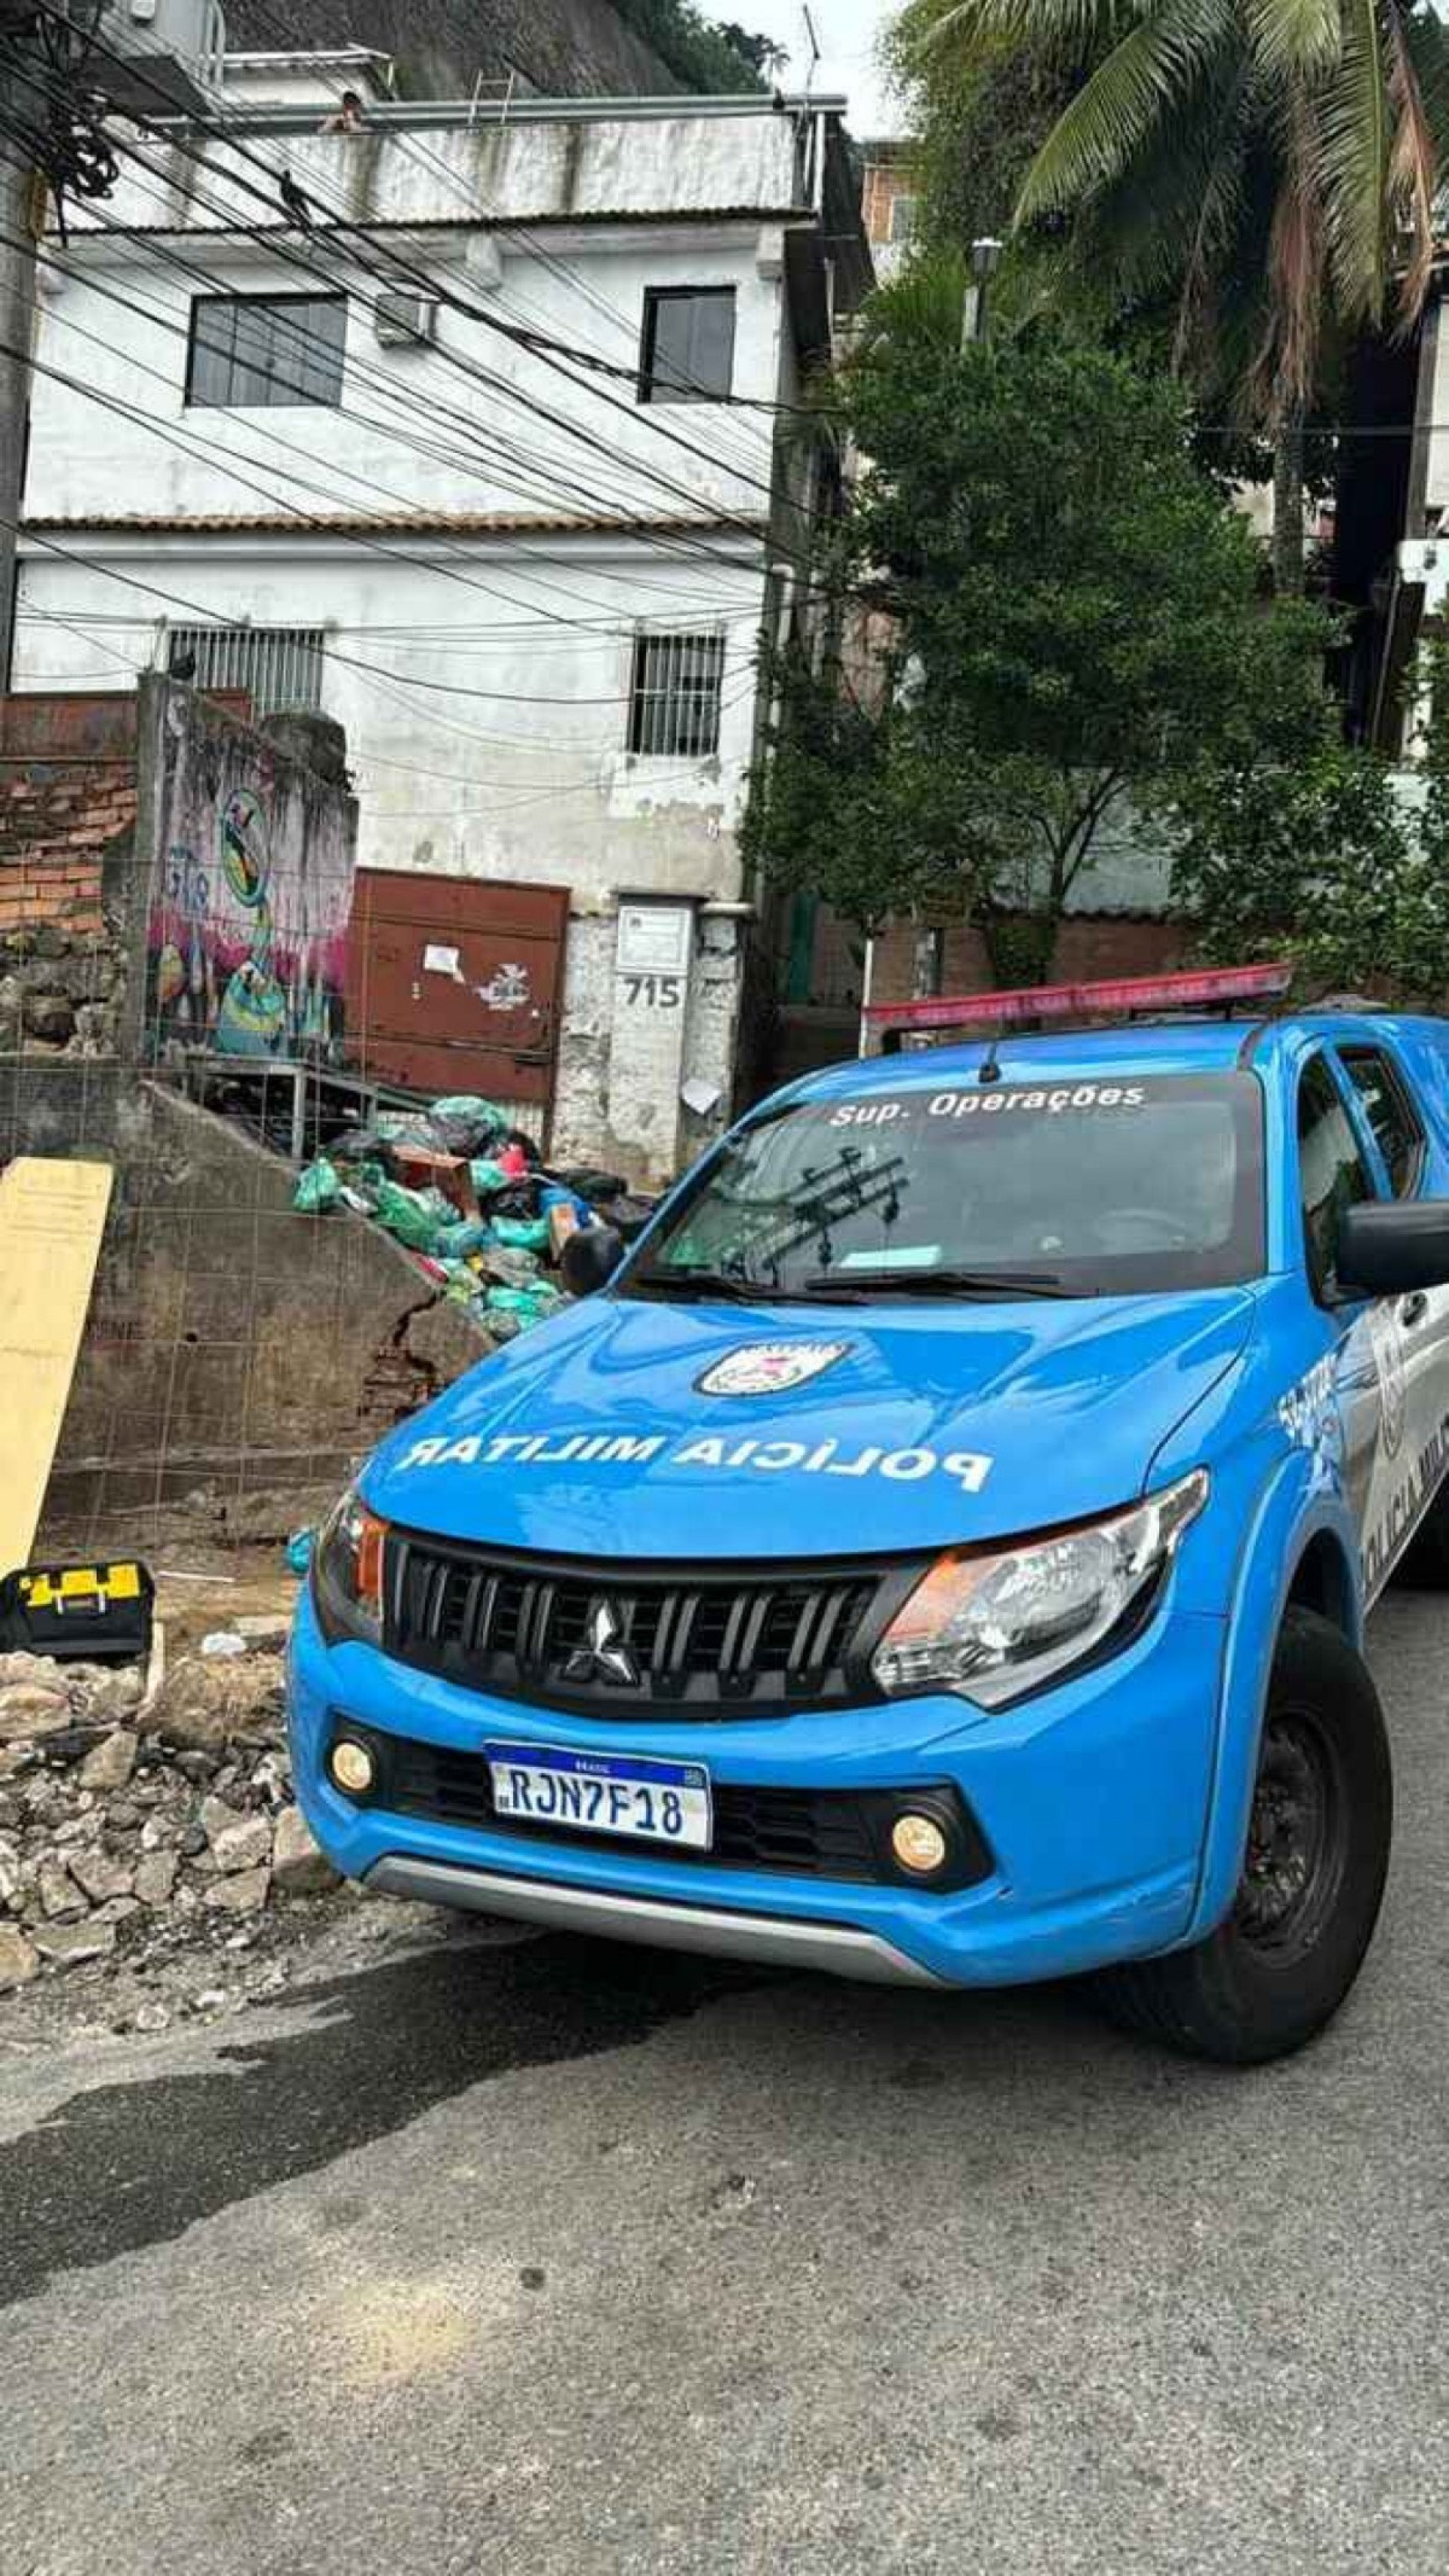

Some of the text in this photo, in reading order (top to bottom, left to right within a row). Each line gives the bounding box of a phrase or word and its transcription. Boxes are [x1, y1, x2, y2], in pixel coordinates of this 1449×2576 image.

[623, 977, 680, 1008] 715
[830, 1084, 1145, 1126] Sup. Operações
[510, 1769, 682, 1836] RJN7F18
